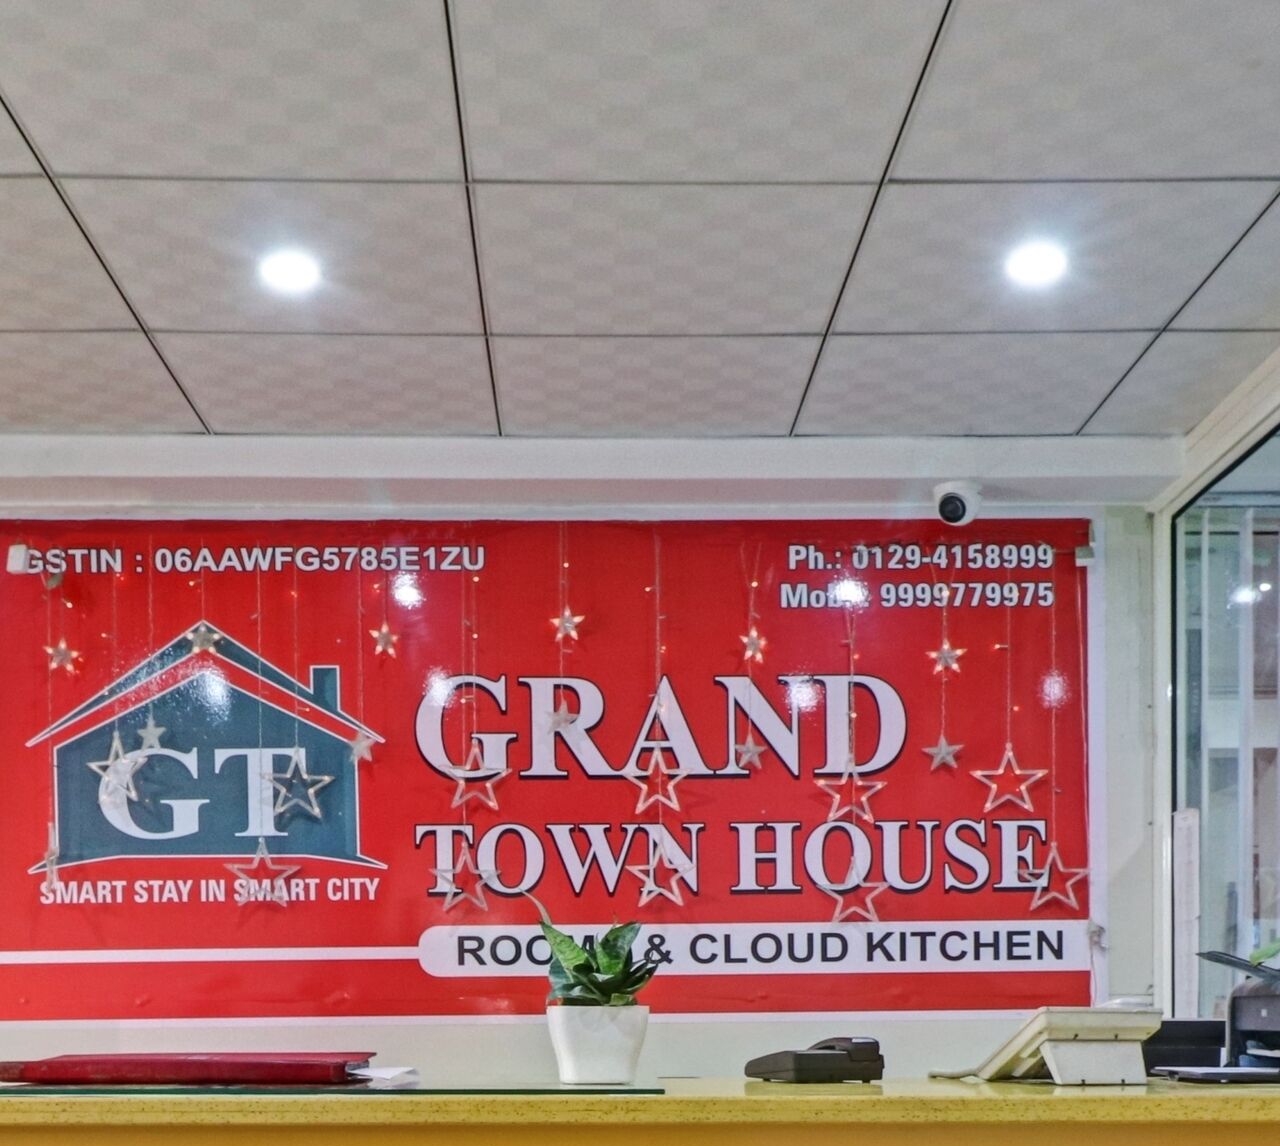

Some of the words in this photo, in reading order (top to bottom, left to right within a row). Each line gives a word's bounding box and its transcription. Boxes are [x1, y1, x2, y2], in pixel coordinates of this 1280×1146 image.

[24, 548, 122, 574] GSTIN
[154, 546, 485, 573] 06AAWFG5785E1ZU
[852, 544, 1054, 570] 0129-4158999
[880, 582, 1054, 608] 9999779975
[414, 673, 907, 780] GRAND
[98, 747, 307, 840] GT
[414, 820, 706, 897] TOWN
[730, 818, 1053, 895] HOUSE
[40, 880, 127, 905] SMART
[133, 880, 193, 903] STAY
[200, 880, 225, 902] IN
[234, 879, 320, 902] SMART
[326, 878, 380, 901] CITY
[457, 934, 596, 967] ROO
[643, 933, 674, 965] &
[689, 931, 849, 966] CLOUD
[867, 929, 1065, 963] KITCHEN
